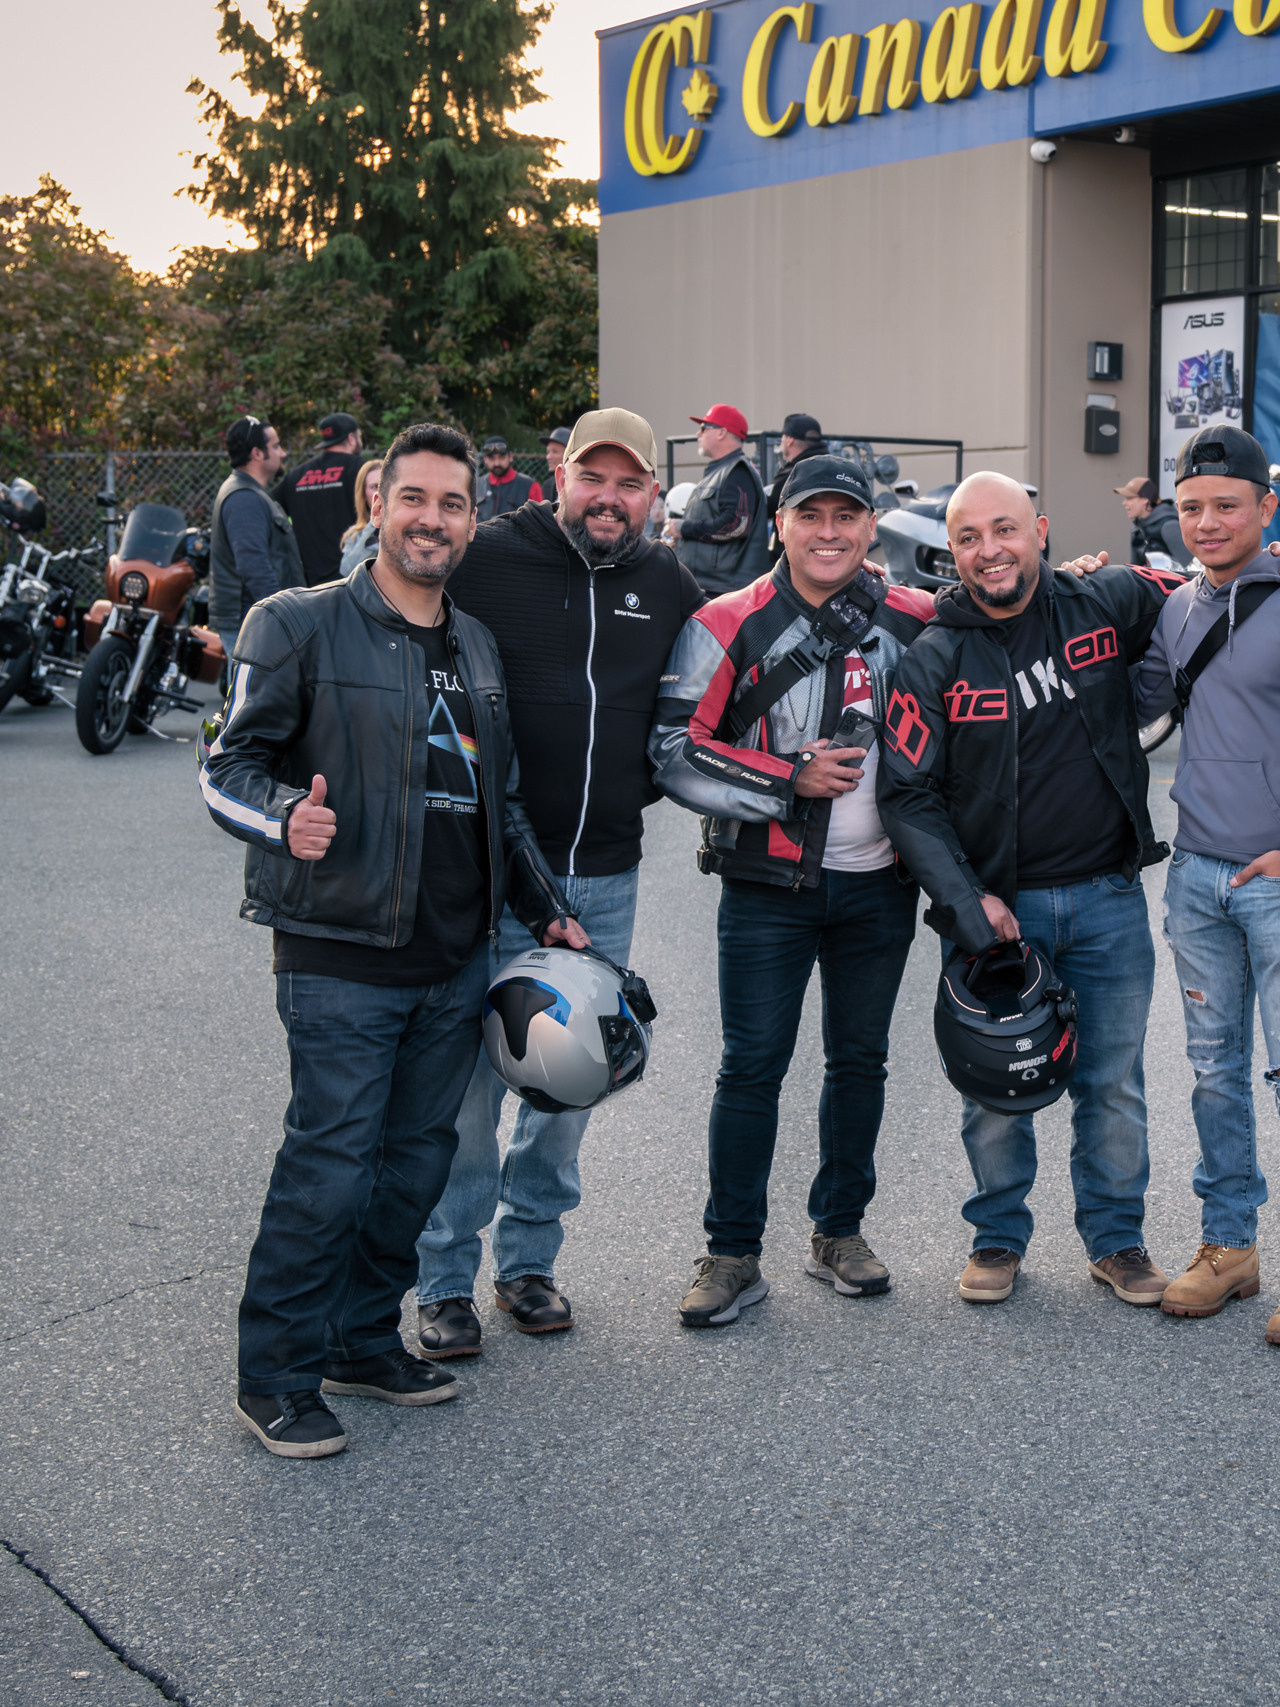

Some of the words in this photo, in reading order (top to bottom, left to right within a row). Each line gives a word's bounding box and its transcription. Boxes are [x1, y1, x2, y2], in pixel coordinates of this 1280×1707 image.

[742, 0, 1109, 138] Canada
[1183, 312, 1225, 330] ASUS
[694, 751, 728, 769] MADE
[740, 771, 773, 786] RACE
[431, 800, 451, 809] SIDE
[1009, 1055, 1047, 1071] SOMAN
